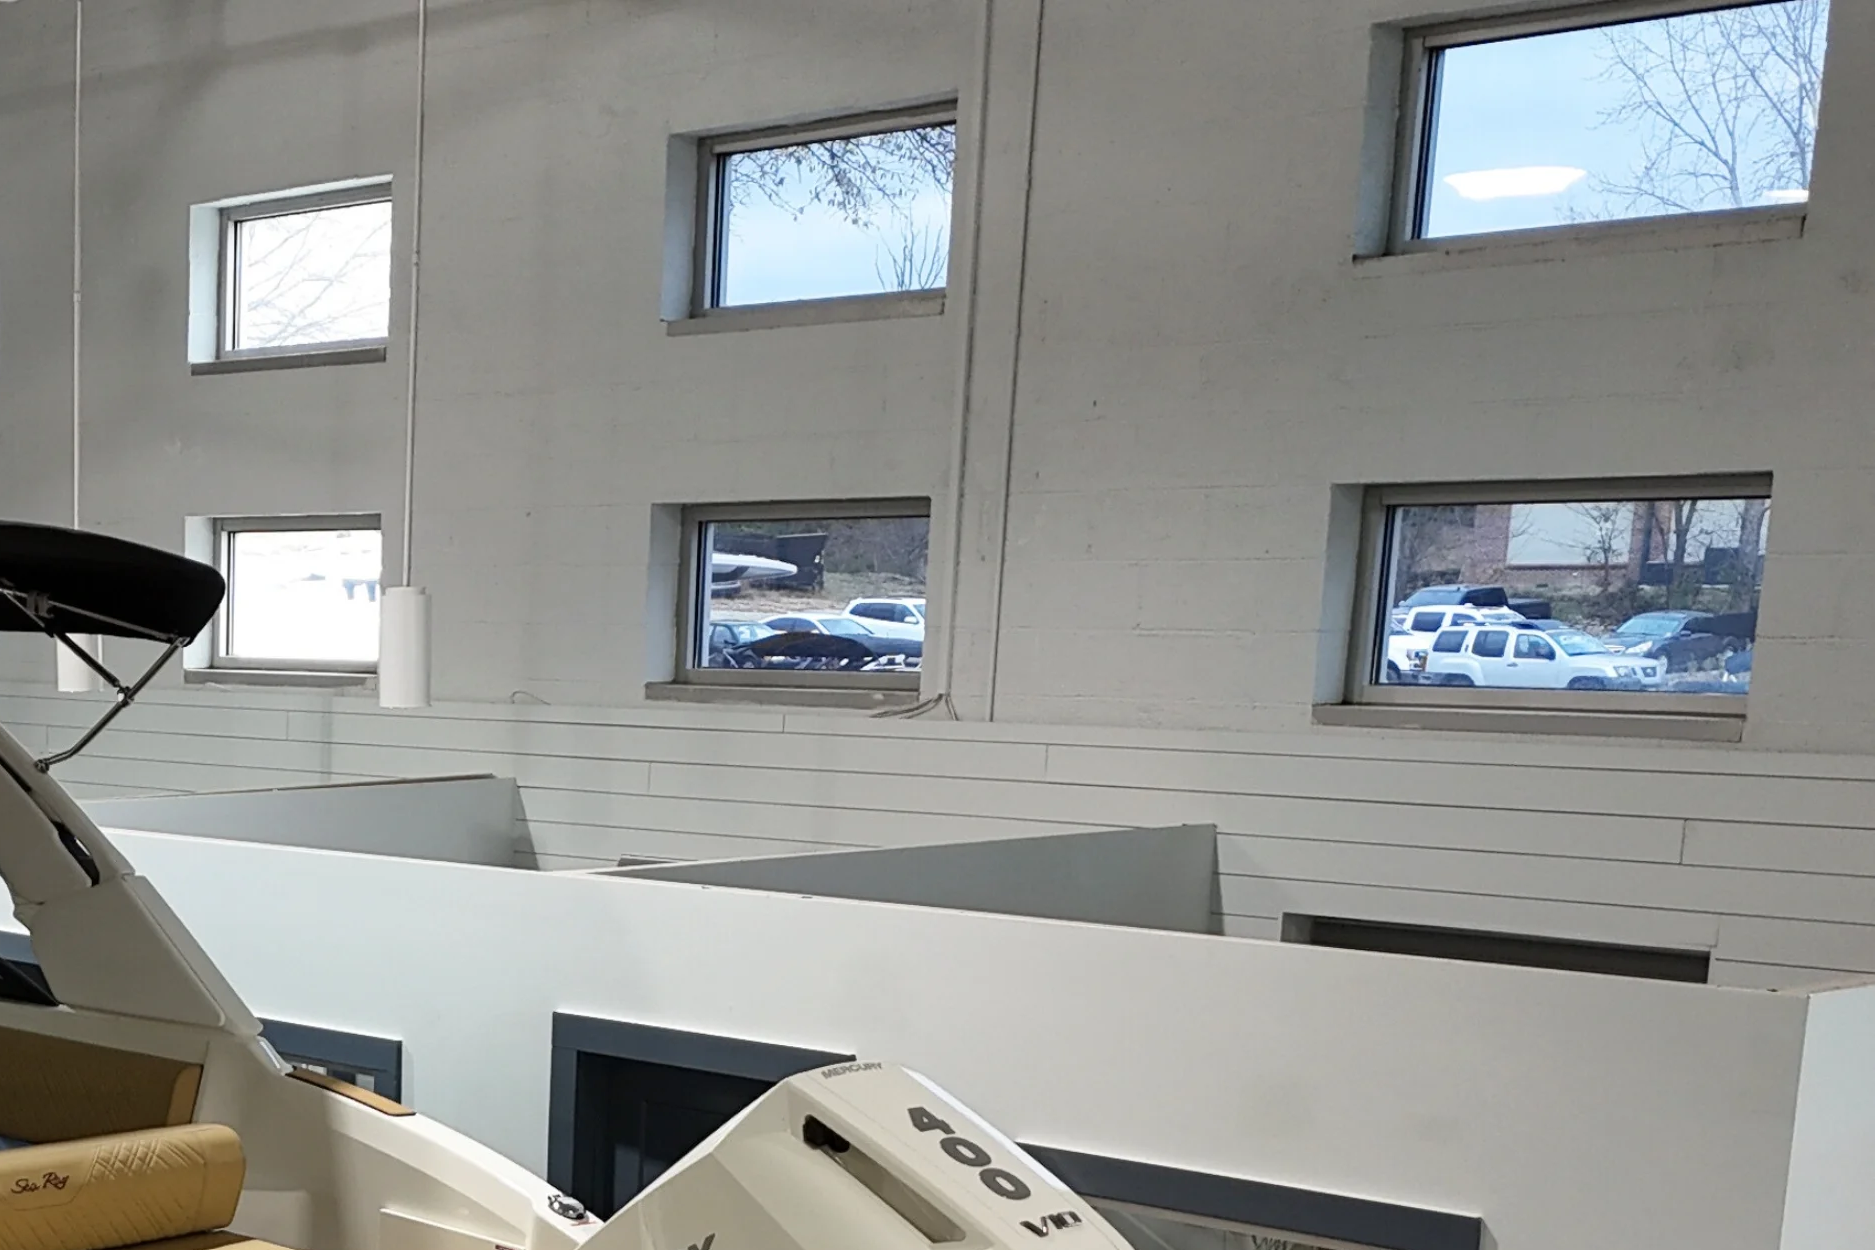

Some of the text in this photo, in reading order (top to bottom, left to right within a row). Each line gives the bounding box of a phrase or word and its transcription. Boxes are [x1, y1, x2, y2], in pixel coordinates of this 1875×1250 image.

[821, 1061, 882, 1080] MERCURY
[907, 1106, 1031, 1201] 400
[9, 1171, 70, 1195] Sea Ray
[1020, 1210, 1083, 1239] V10
